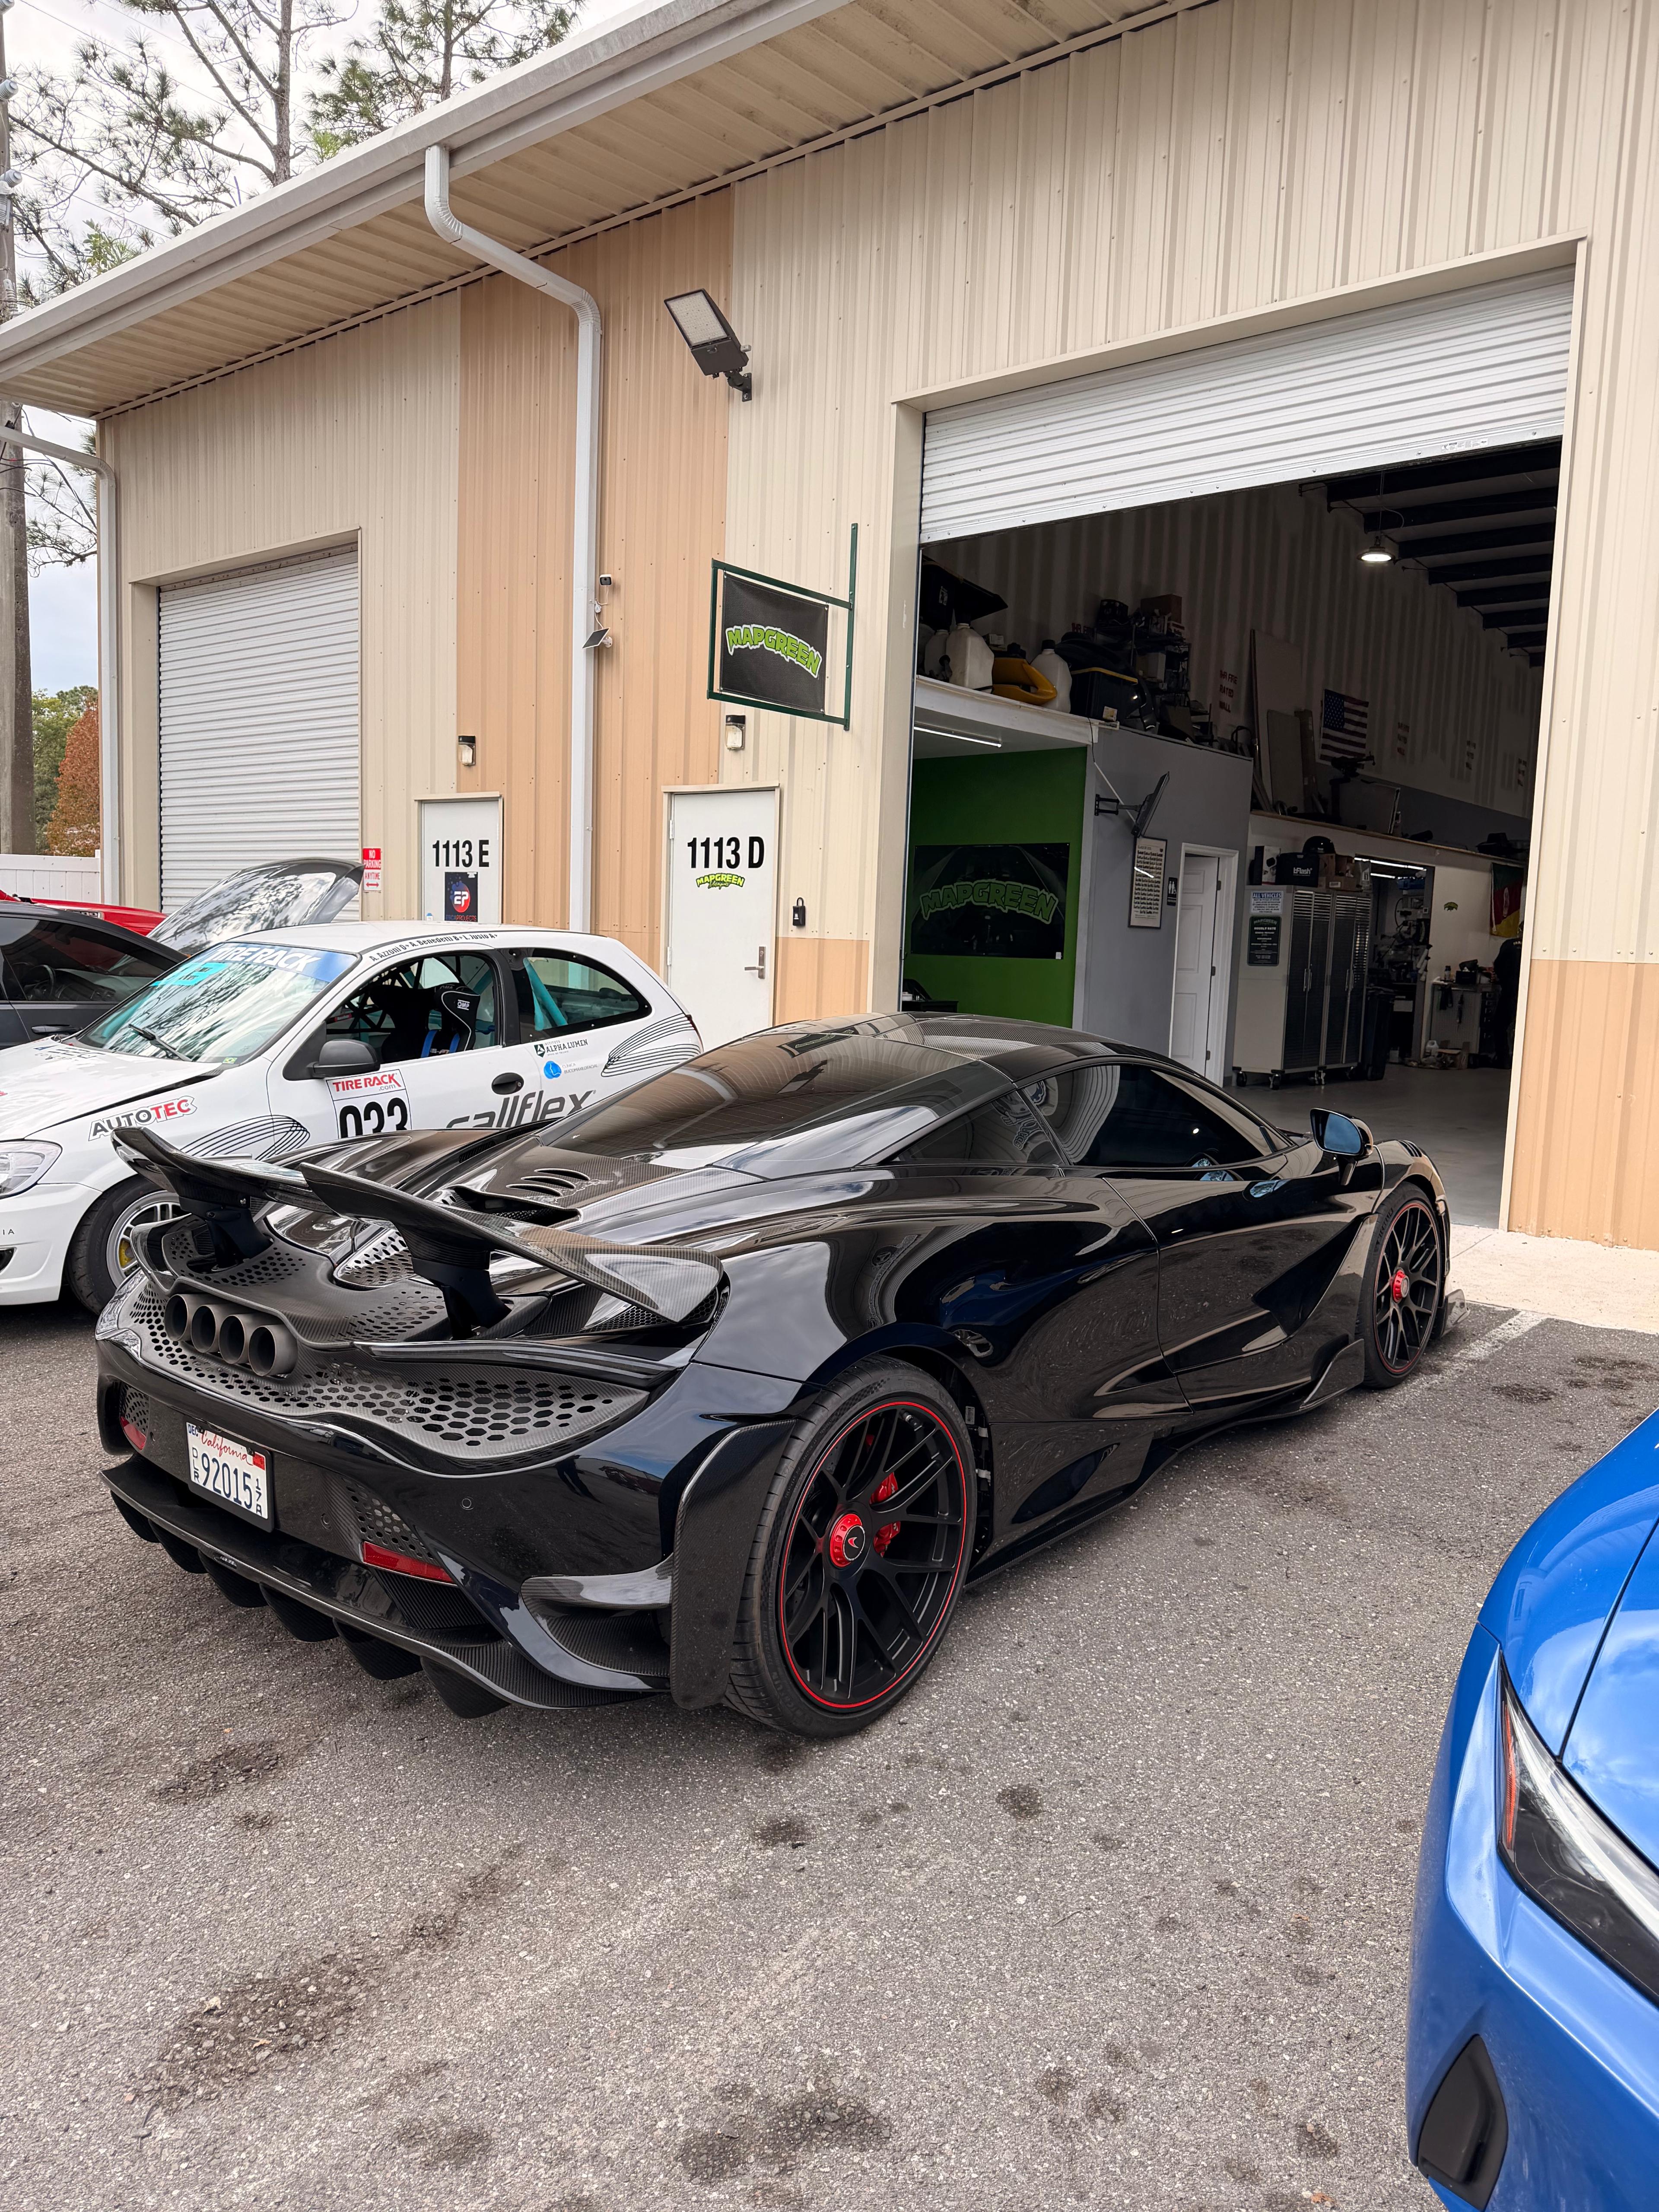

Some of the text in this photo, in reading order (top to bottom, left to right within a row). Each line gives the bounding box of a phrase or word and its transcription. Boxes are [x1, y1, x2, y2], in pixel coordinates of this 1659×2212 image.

[726, 624, 822, 678] MAPGREEN
[363, 859, 381, 869] PARKING
[369, 850, 375, 858] NO
[432, 839, 489, 868] 1113 E
[687, 836, 764, 869] 1113 D
[696, 873, 745, 888] MAPGREEN
[920, 879, 1058, 924] MAPGREEN
[419, 936, 453, 945] Benedetti
[205, 947, 321, 972] TIRE RACK
[546, 1039, 588, 1053] ALPHA LUMEN
[333, 1073, 402, 1092] TIRE RACK
[92, 1099, 191, 1137] AUTOTEC
[201, 1430, 254, 1466] California
[201, 1452, 252, 1510] 92015
